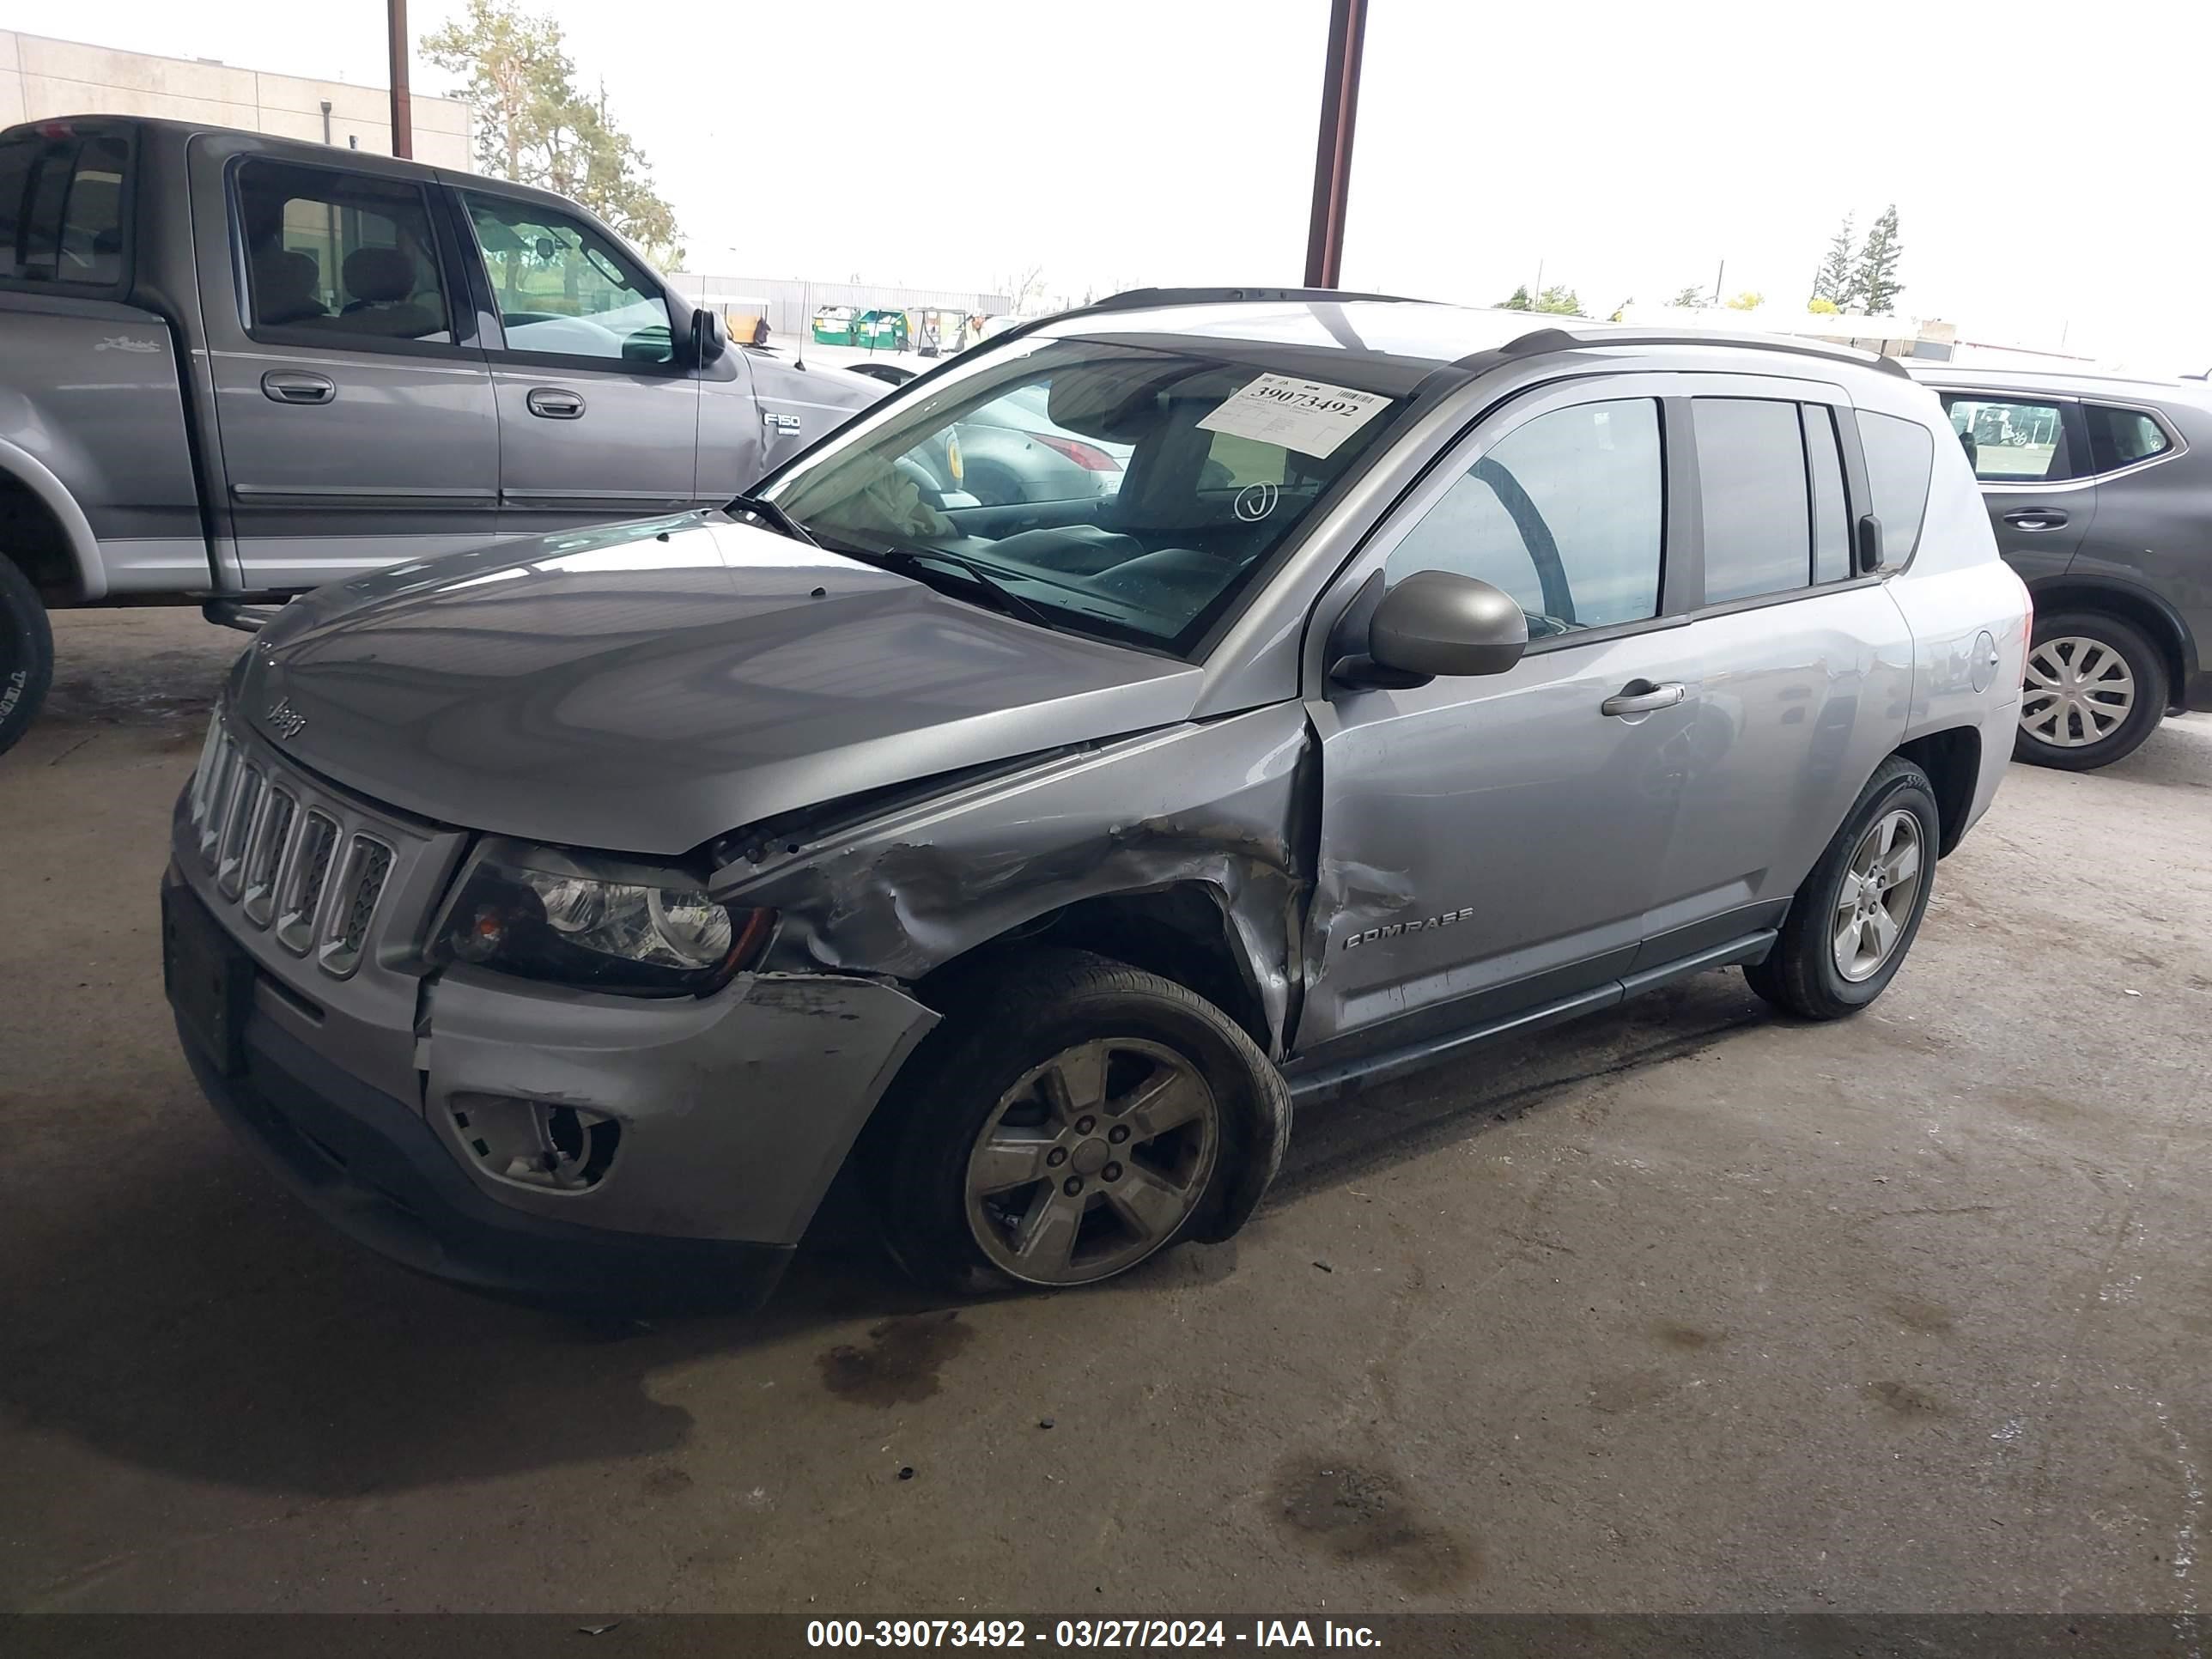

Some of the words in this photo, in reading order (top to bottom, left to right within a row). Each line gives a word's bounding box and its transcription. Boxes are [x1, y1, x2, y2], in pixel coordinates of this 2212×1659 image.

[764, 413, 801, 427] F150
[1250, 386, 1359, 417] 39073492
[265, 696, 307, 740] Jeep
[1345, 907, 1474, 950] COMPASS
